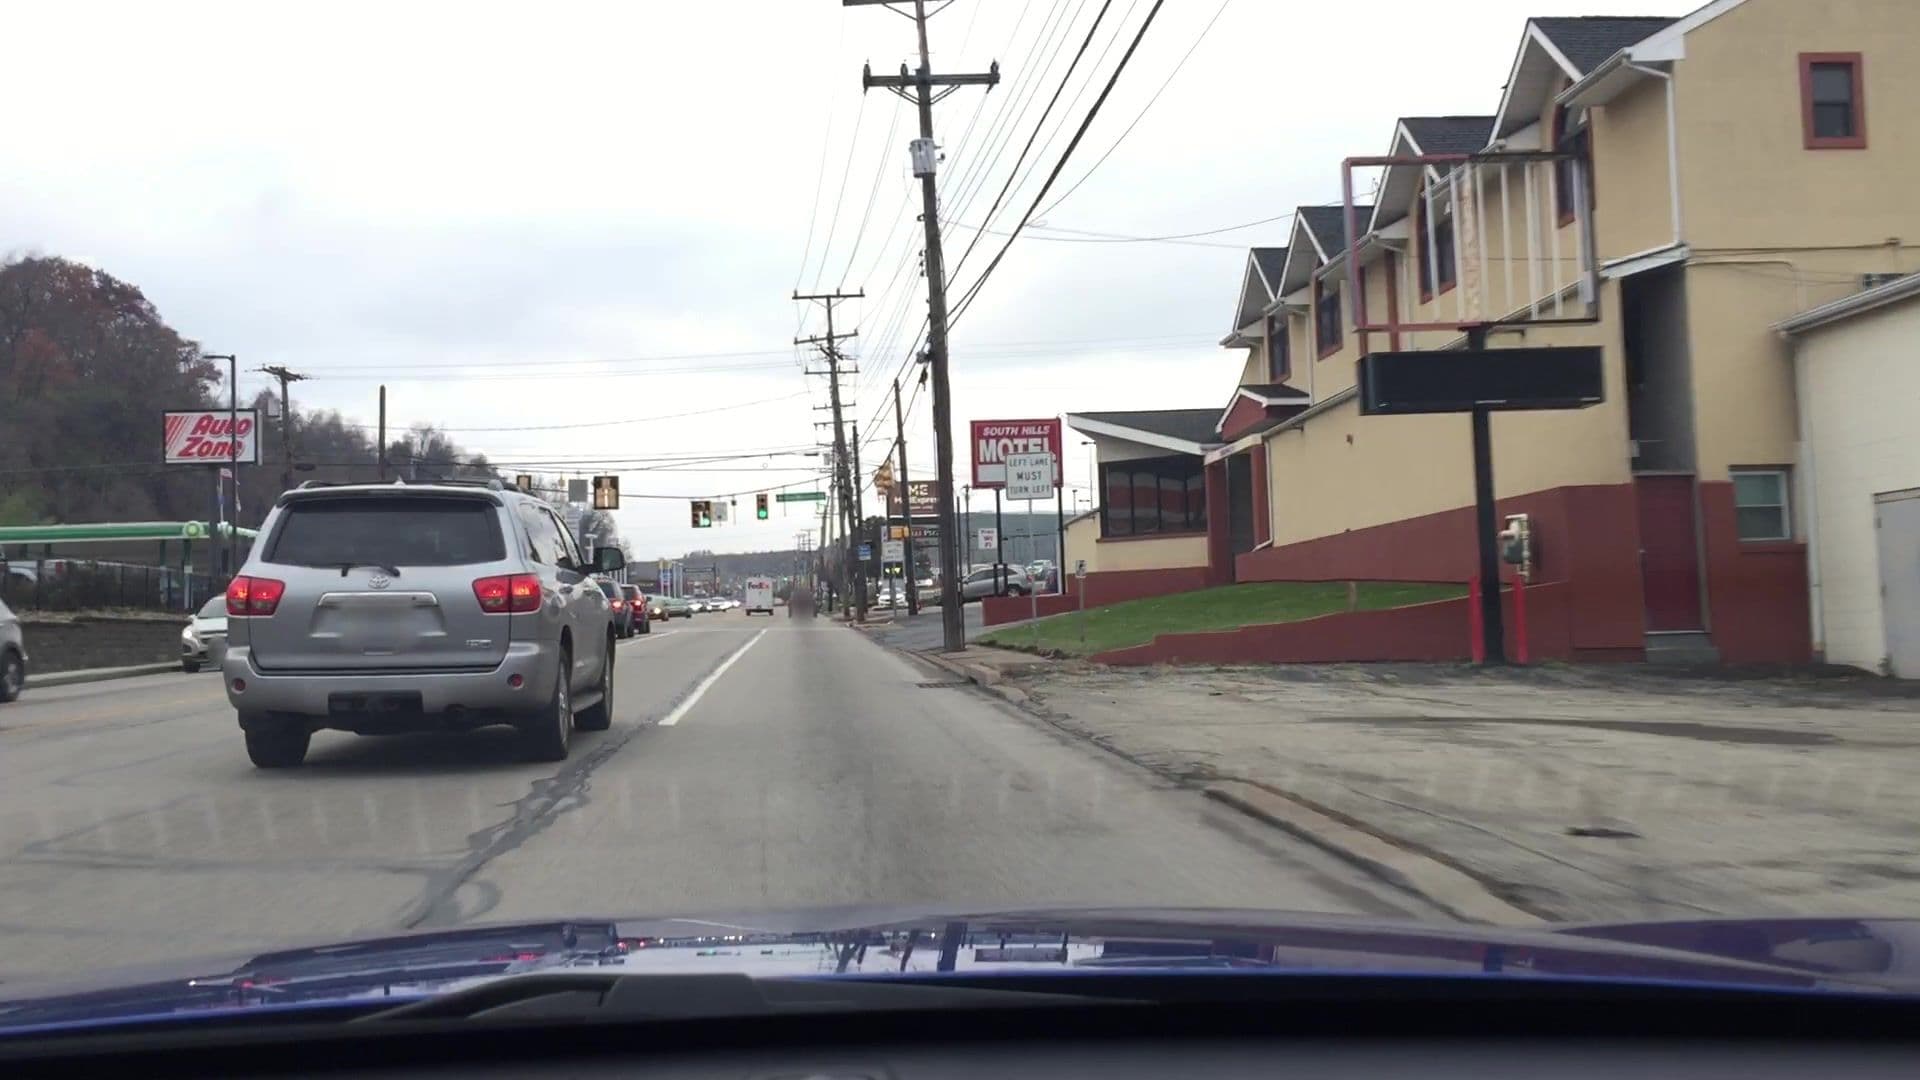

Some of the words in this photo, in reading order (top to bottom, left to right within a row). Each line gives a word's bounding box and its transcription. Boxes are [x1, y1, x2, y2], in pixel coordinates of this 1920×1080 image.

[191, 414, 252, 436] Auto
[983, 426, 1018, 436] SOUTH
[1021, 425, 1051, 435] HILLS
[178, 437, 244, 457] Zone
[1009, 458, 1027, 467] LEFT
[1030, 458, 1049, 466] LANE
[1016, 471, 1042, 481] MUST
[1009, 485, 1029, 495] TURN
[1032, 485, 1050, 493] LEFT
[748, 581, 769, 589] FedEx
